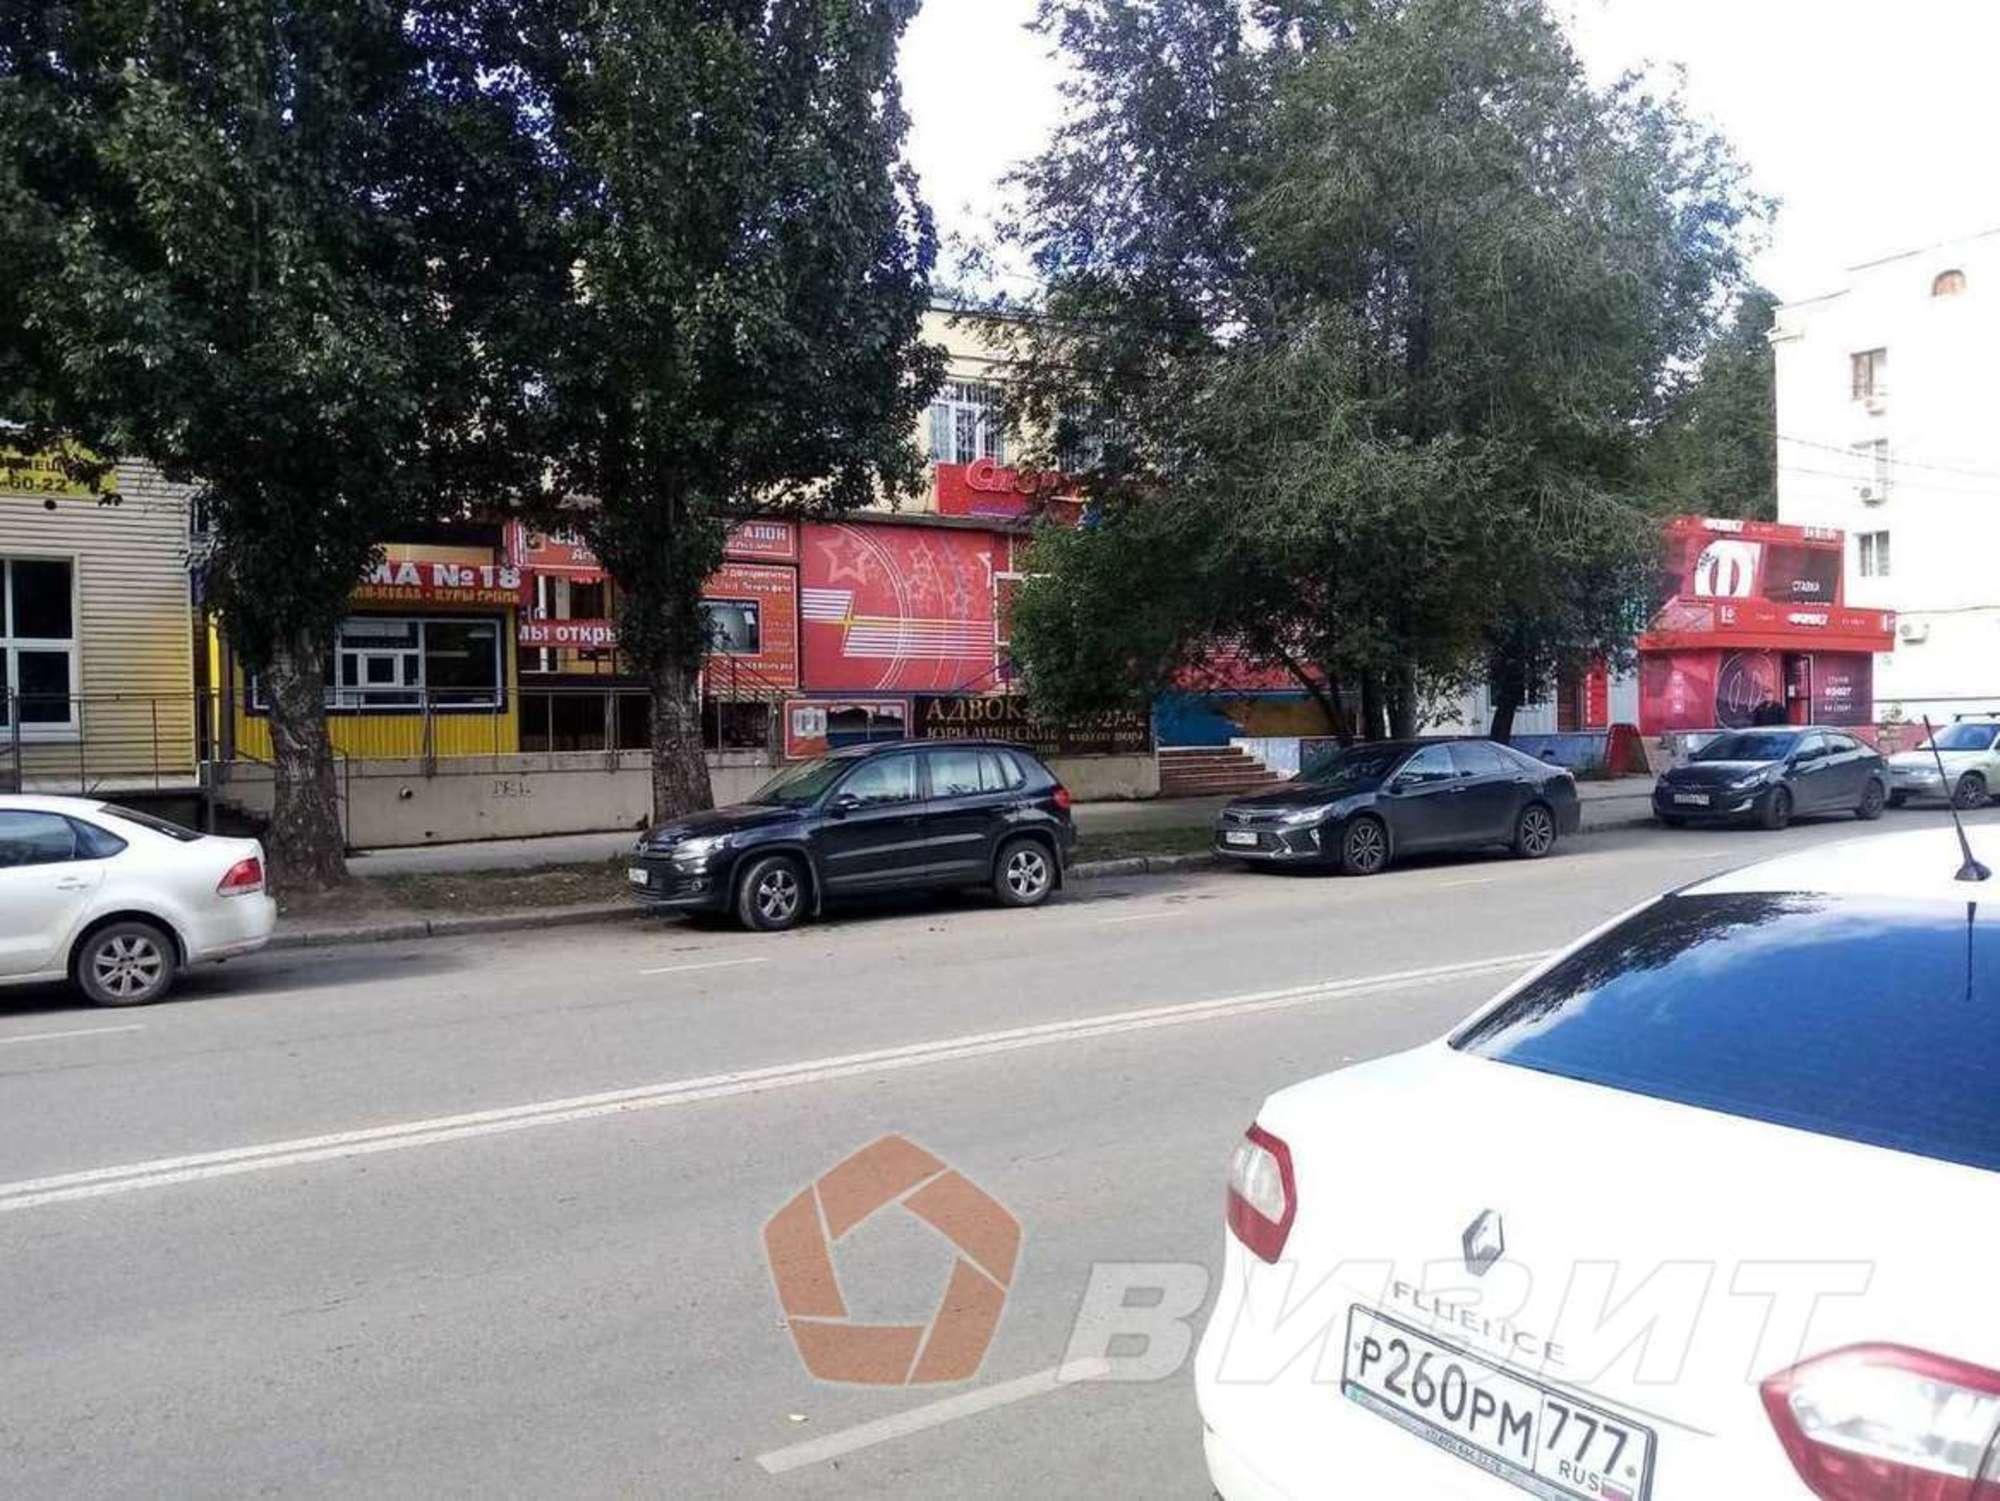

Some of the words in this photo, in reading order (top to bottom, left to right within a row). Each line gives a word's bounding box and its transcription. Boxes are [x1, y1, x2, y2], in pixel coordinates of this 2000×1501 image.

[737, 526, 786, 540] АЛОН
[1393, 1281, 1565, 1366] FLUENCE
[1546, 1400, 1628, 1476] 777
[1557, 1459, 1599, 1492] RUS
